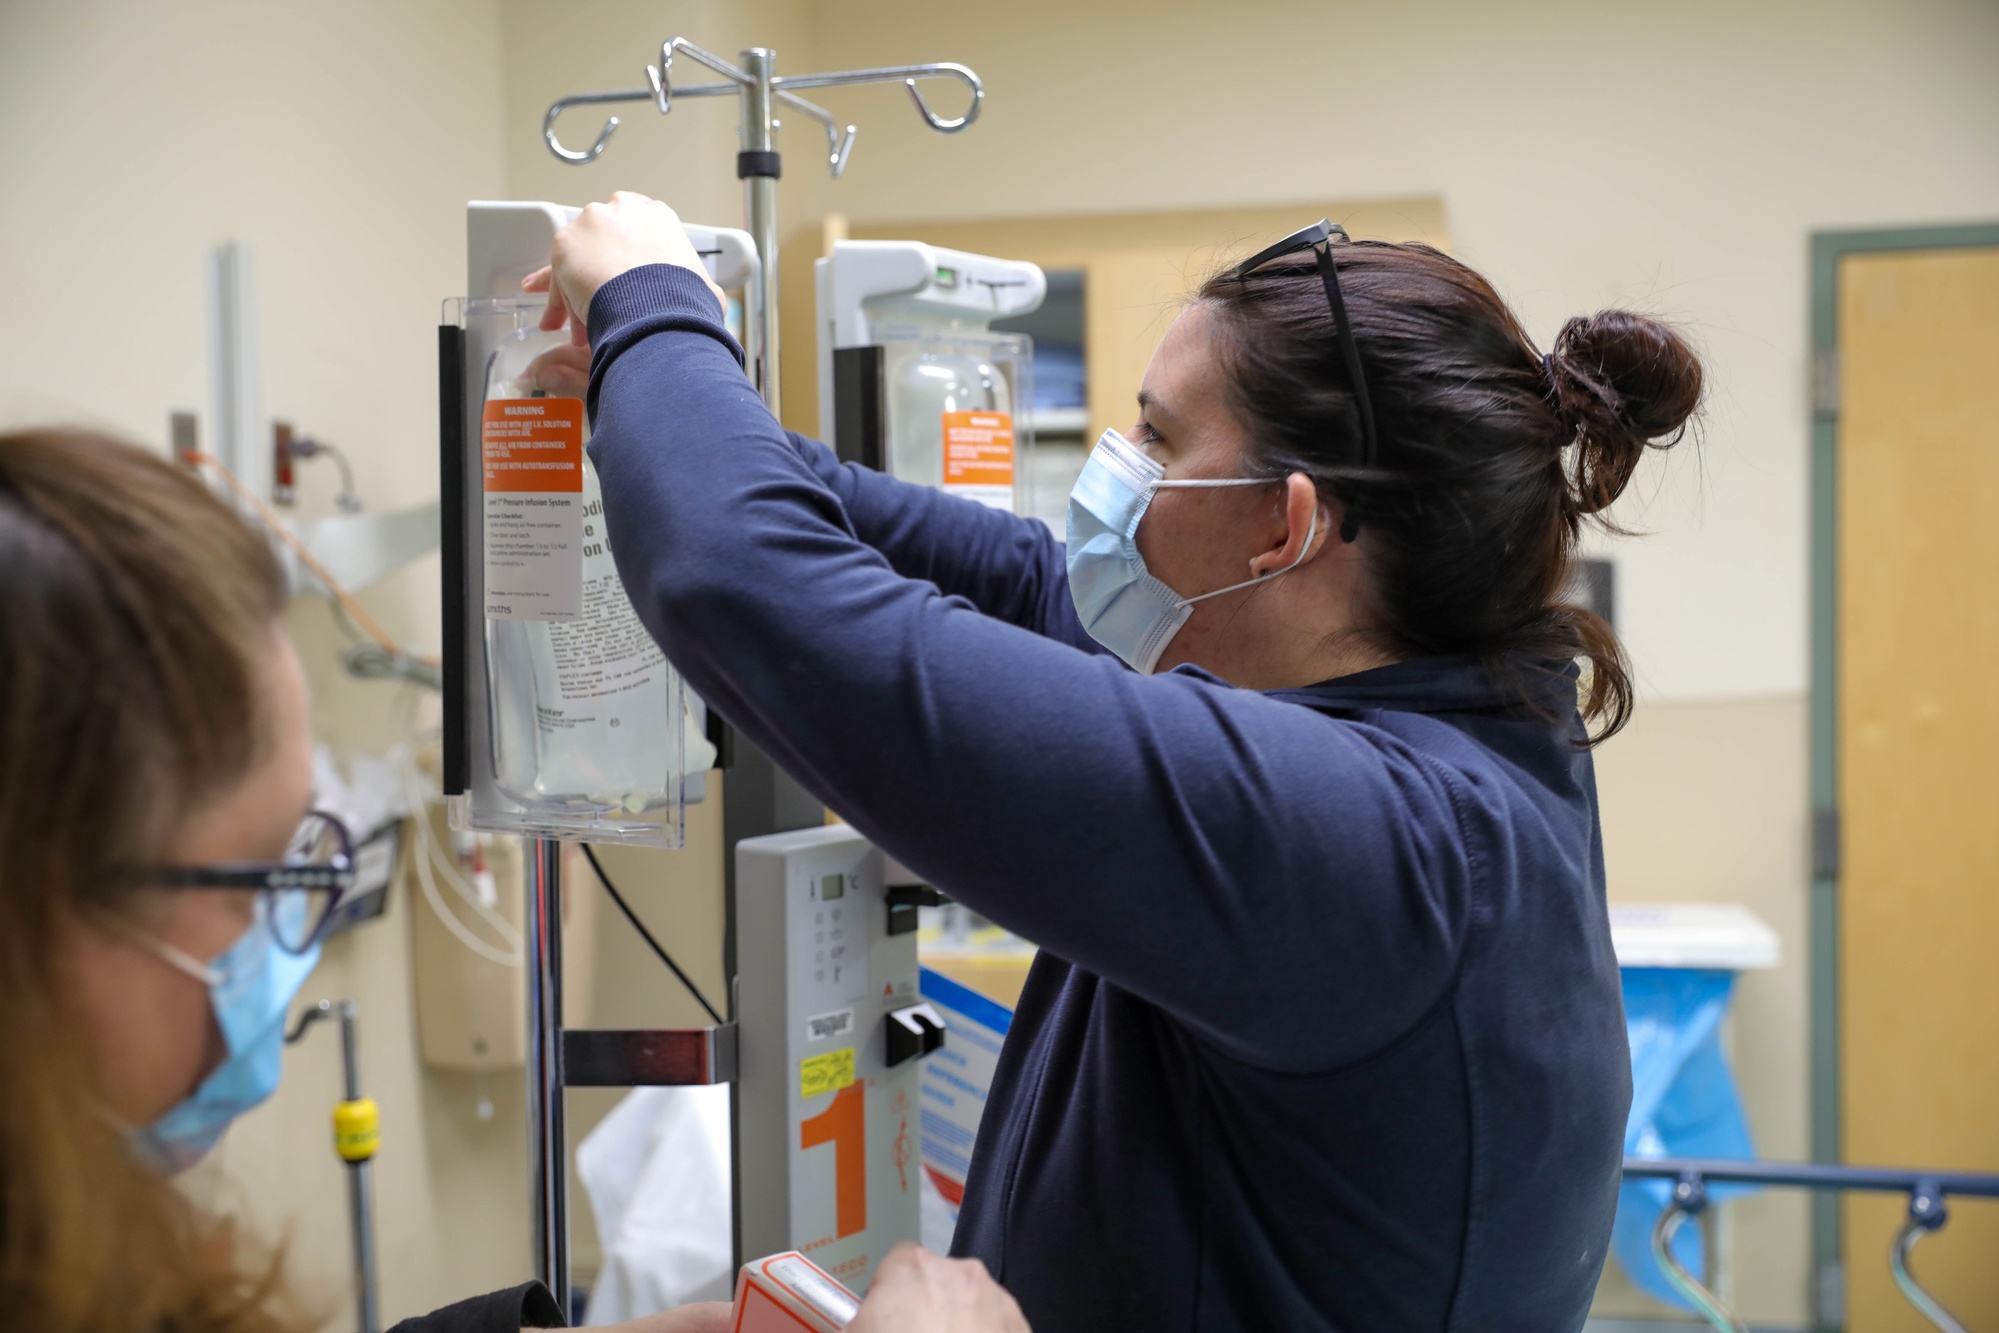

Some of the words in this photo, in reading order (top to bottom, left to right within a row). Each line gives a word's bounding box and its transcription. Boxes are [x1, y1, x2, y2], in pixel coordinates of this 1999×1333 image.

[504, 406, 545, 416] WARNING
[543, 420, 572, 428] SOLUTION
[532, 441, 566, 449] CONTAINERS
[522, 462, 575, 470] AUTOTRANSFUSION
[503, 498, 524, 506] Pressure
[525, 498, 548, 506] Infusion
[549, 498, 571, 508] System
[801, 1078, 867, 1240] 1
